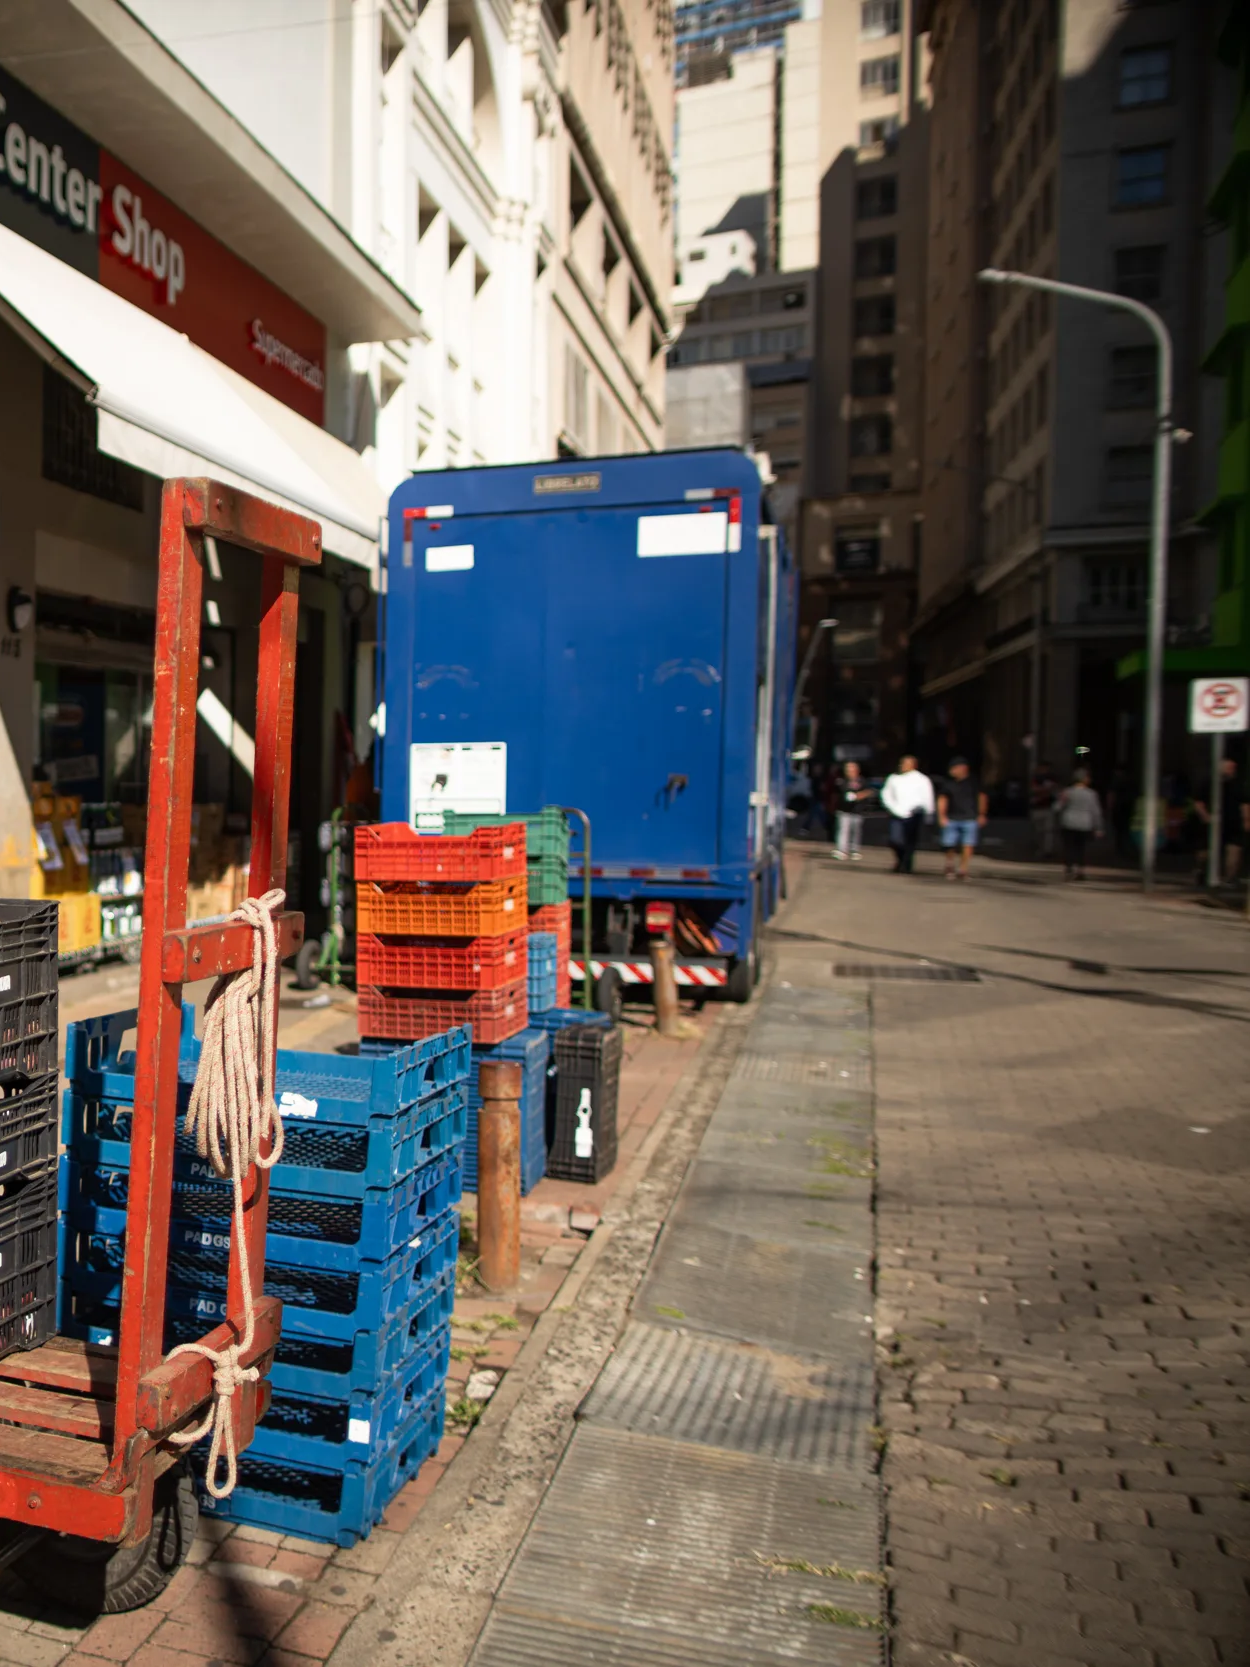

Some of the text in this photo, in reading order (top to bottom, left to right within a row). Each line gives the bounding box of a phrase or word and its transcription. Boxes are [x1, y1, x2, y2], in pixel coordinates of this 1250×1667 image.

[112, 184, 185, 305] Shop
[184, 1230, 212, 1245] PAD
[189, 1298, 216, 1314] PAD
